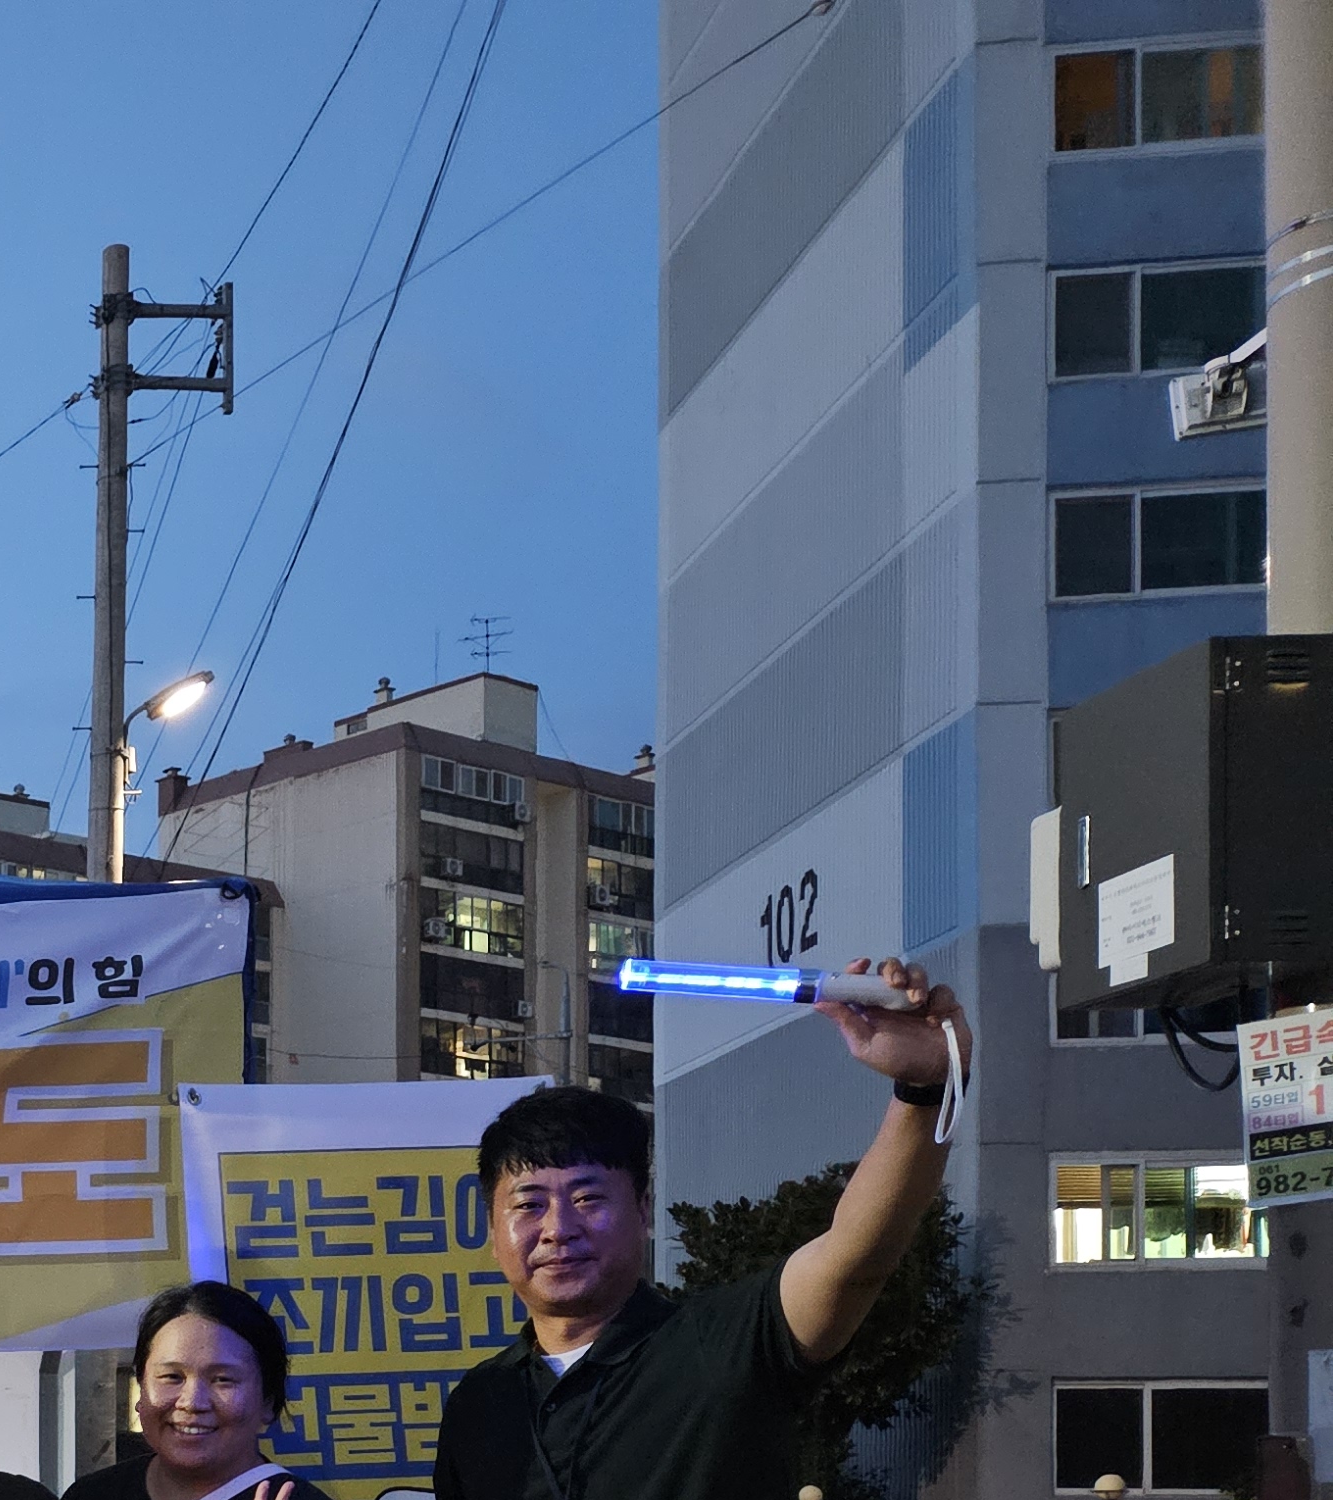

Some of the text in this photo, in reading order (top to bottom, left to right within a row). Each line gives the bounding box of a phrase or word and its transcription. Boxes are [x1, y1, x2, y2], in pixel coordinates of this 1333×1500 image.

[760, 868, 818, 968] 102
[91, 954, 145, 1000] 힘
[1251, 1061, 1303, 1087] 투자.
[1251, 1090, 1299, 1110] 59타입
[1251, 1111, 1300, 1131] 84타입
